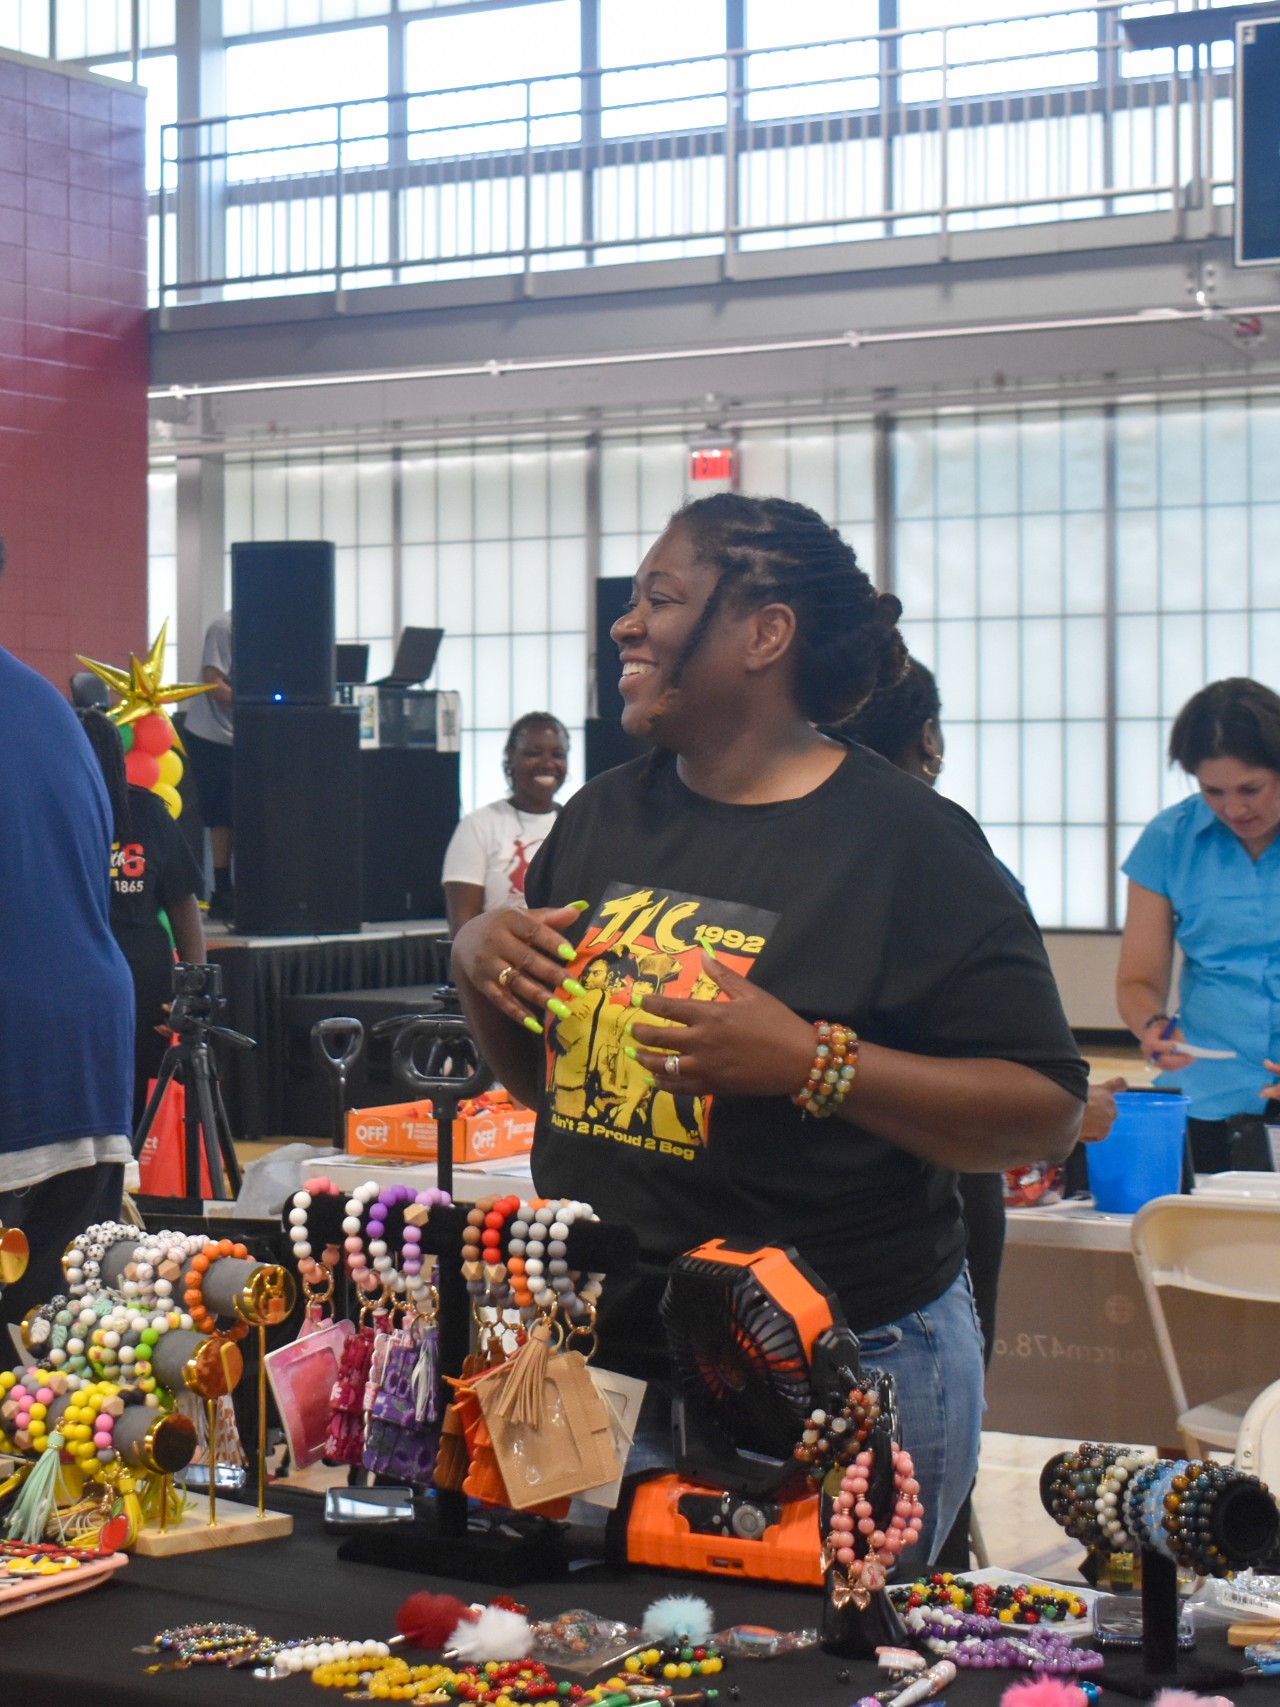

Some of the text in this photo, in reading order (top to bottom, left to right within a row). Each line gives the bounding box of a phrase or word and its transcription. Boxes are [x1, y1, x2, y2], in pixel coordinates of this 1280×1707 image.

[114, 880, 144, 893] 1865
[588, 890, 700, 954] TLC
[695, 924, 767, 954] 1992
[355, 1124, 389, 1143] OFF!
[472, 1127, 498, 1150] OFF!
[550, 1113, 575, 1134] Ain't
[576, 1120, 591, 1135] 2
[592, 1124, 642, 1149] Proud
[643, 1137, 659, 1151] 2
[659, 1140, 695, 1162] Beg
